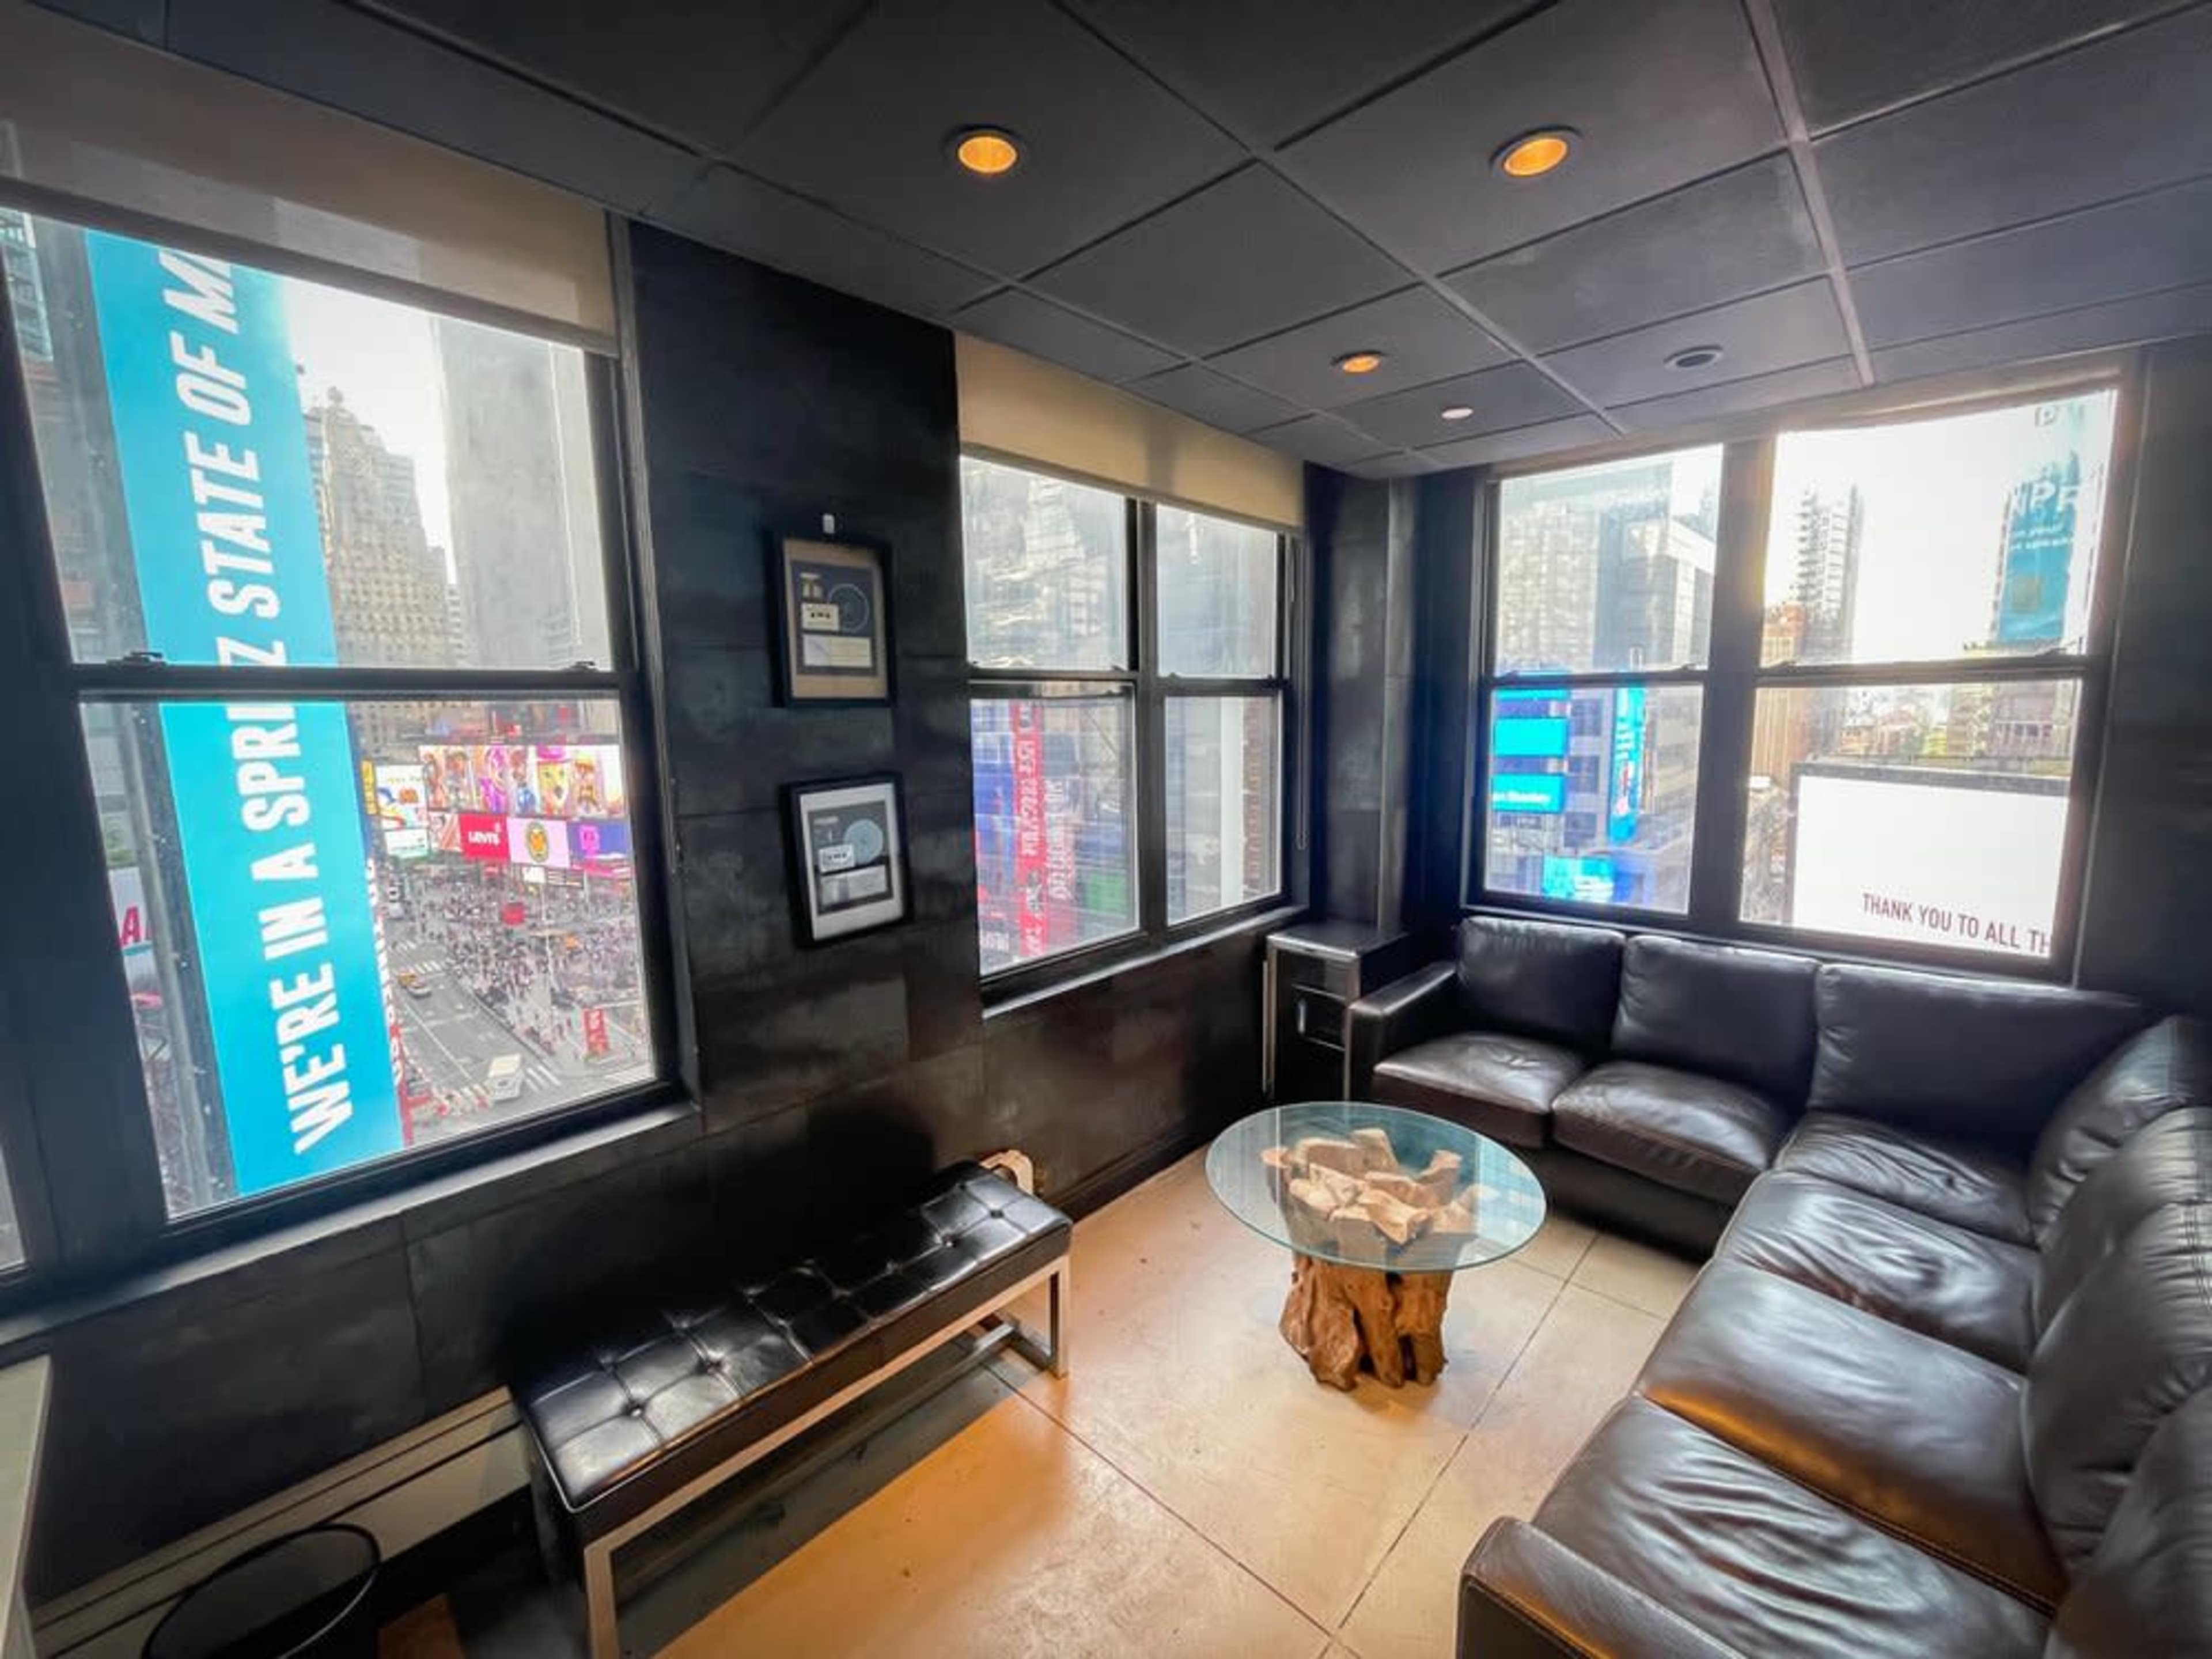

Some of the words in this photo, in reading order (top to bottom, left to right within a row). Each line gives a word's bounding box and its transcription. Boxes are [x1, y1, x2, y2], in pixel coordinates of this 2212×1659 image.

[170, 330, 252, 425] OF
[184, 431, 282, 619] STATE
[216, 636, 311, 832] SPRIZ
[250, 842, 320, 881] A
[257, 896, 331, 961] IN
[1863, 893, 1913, 922] THANK
[1919, 906, 1952, 932] YOU
[1957, 914, 1979, 939] TO
[1984, 922, 2020, 949] ALL
[269, 961, 354, 1154] WE'RE
